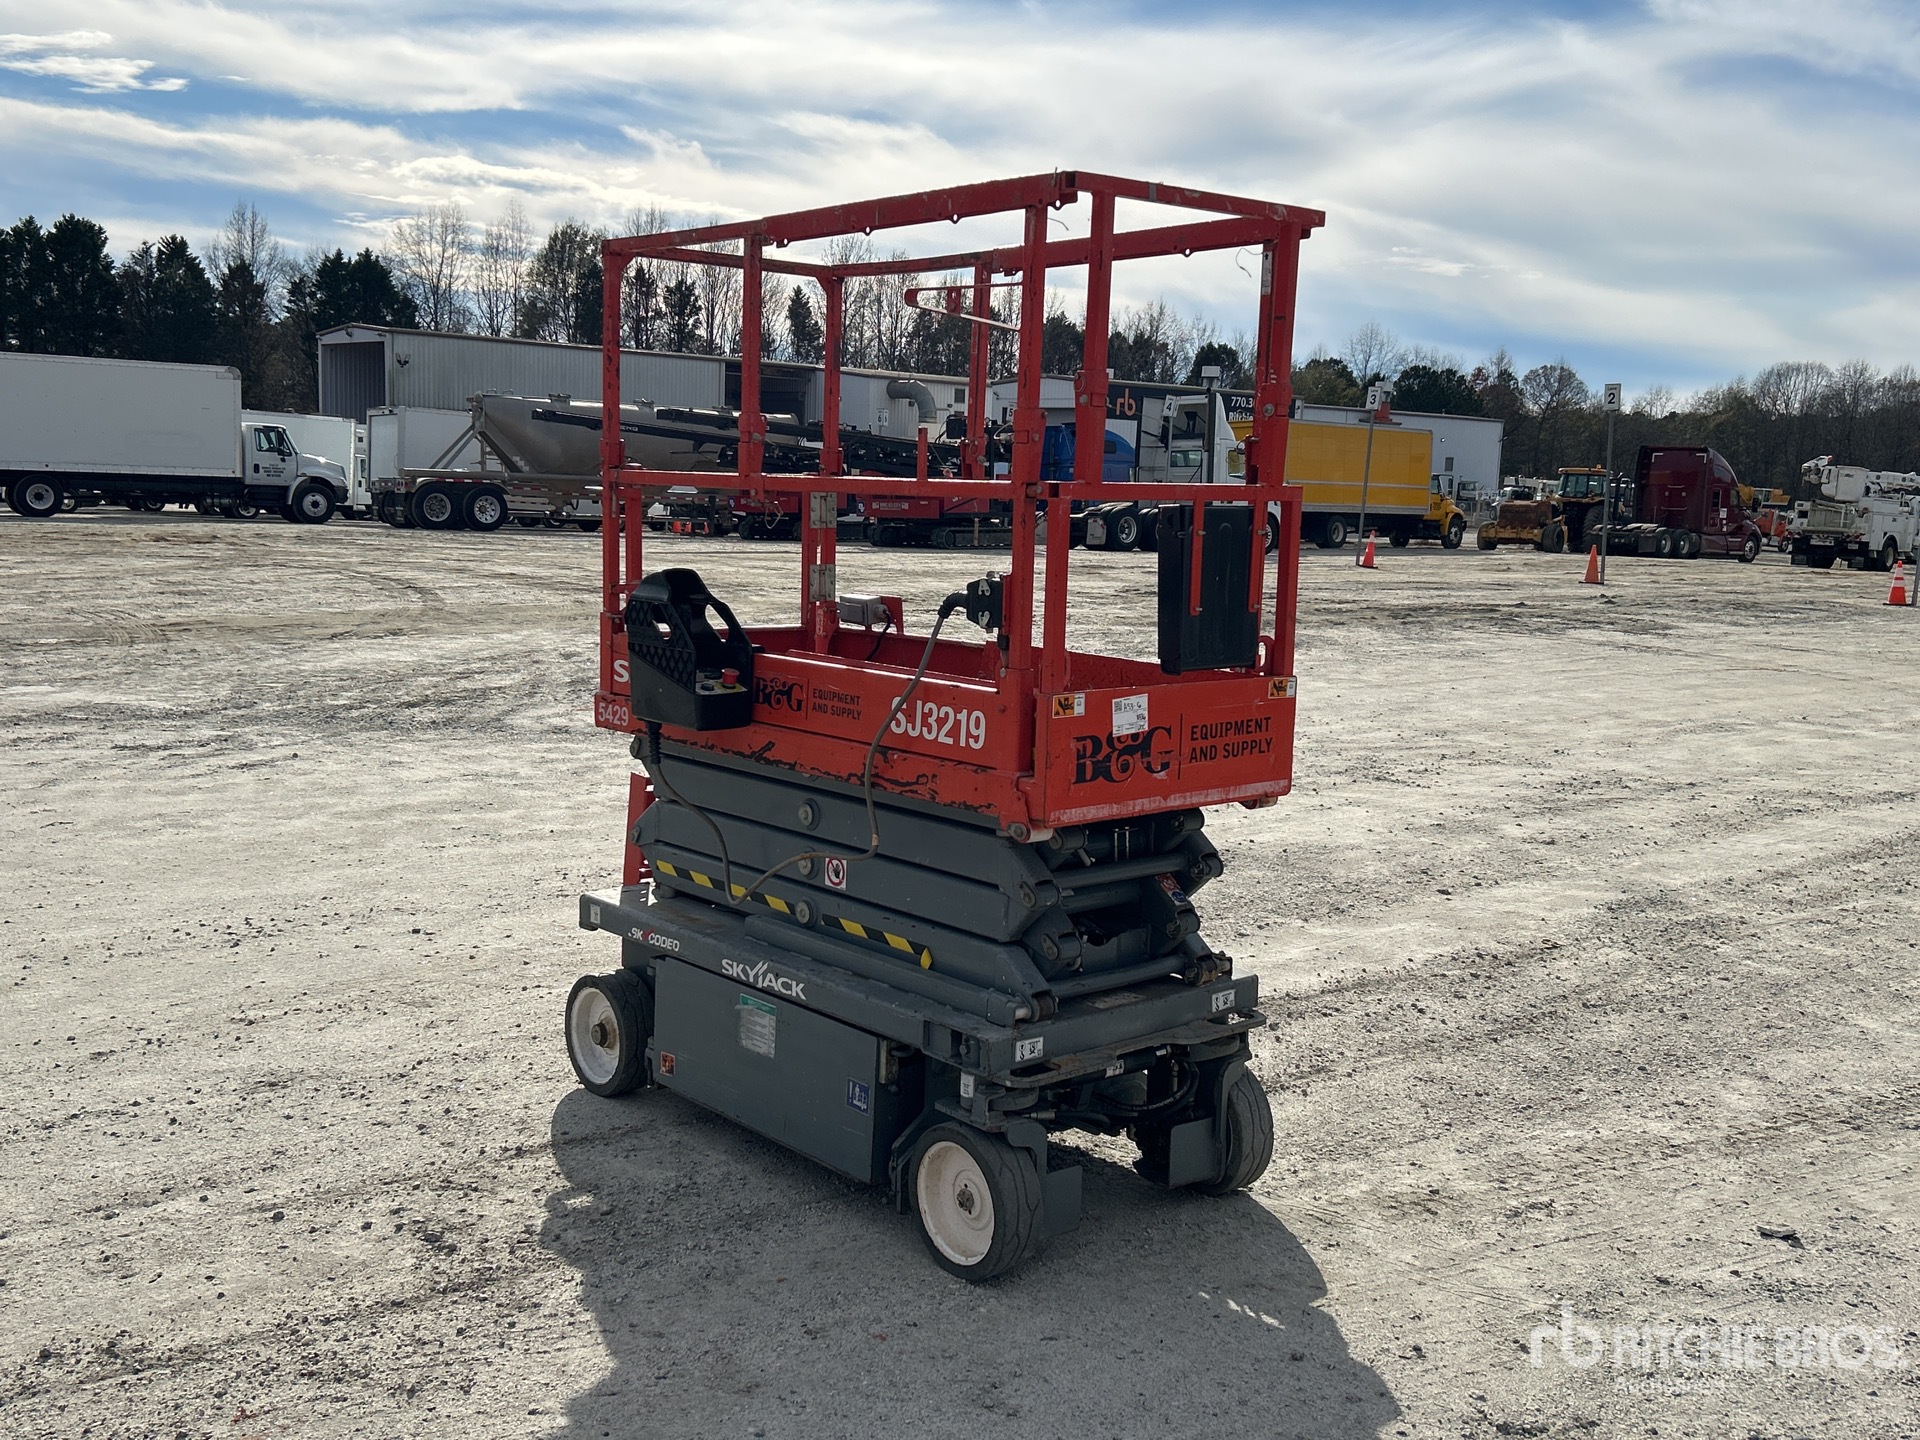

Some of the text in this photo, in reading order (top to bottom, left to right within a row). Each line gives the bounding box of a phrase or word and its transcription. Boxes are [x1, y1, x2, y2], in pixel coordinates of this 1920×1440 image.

[1115, 388, 1136, 417] rb
[1166, 402, 1172, 412] 4
[1231, 396, 1255, 408] 770.3
[1370, 394, 1377, 405] 3
[1607, 392, 1616, 404] 2
[877, 414, 882, 423] 6
[1008, 407, 1014, 417] 5
[812, 687, 861, 706] EQUIPMENT
[598, 702, 629, 726] 5429
[811, 701, 862, 720] AND SUPPLY
[890, 696, 986, 750] SJ3219
[1190, 716, 1272, 742] EQUIPMENT
[1072, 725, 1174, 785] B&G
[1189, 737, 1274, 764] AND SUPPLY
[721, 958, 807, 1001] SKYJACK
